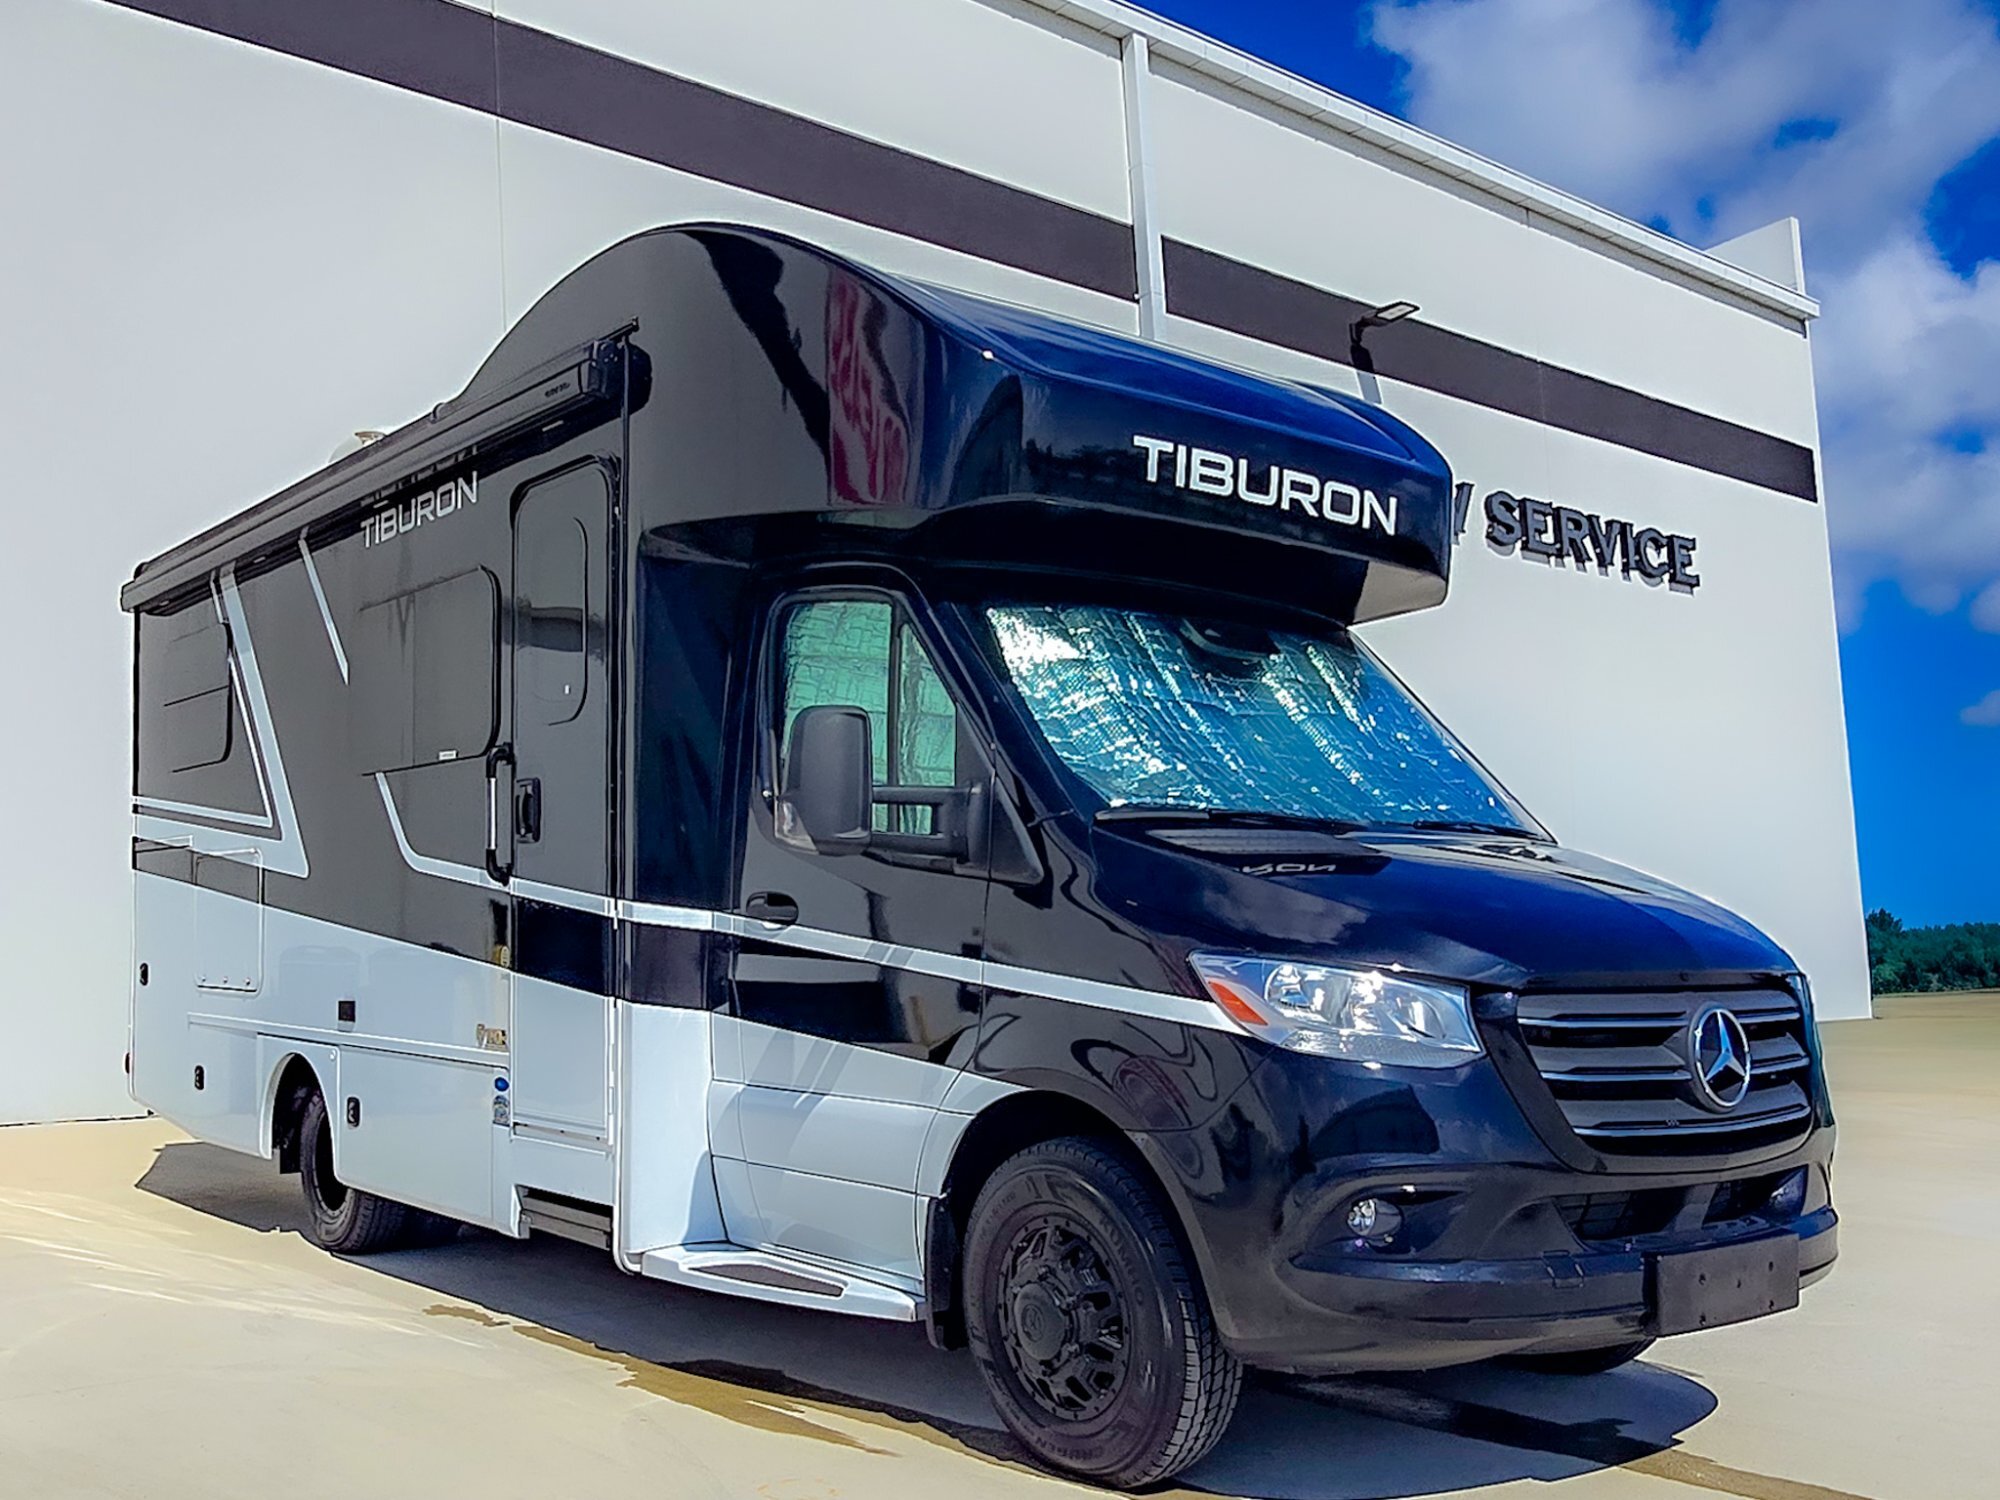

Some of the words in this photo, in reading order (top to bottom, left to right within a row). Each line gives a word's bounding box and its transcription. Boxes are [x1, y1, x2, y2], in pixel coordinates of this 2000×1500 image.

[360, 470, 478, 548] TIBURON
[1132, 435, 1398, 536] TIBURON
[1484, 490, 1700, 589] SERVICE
